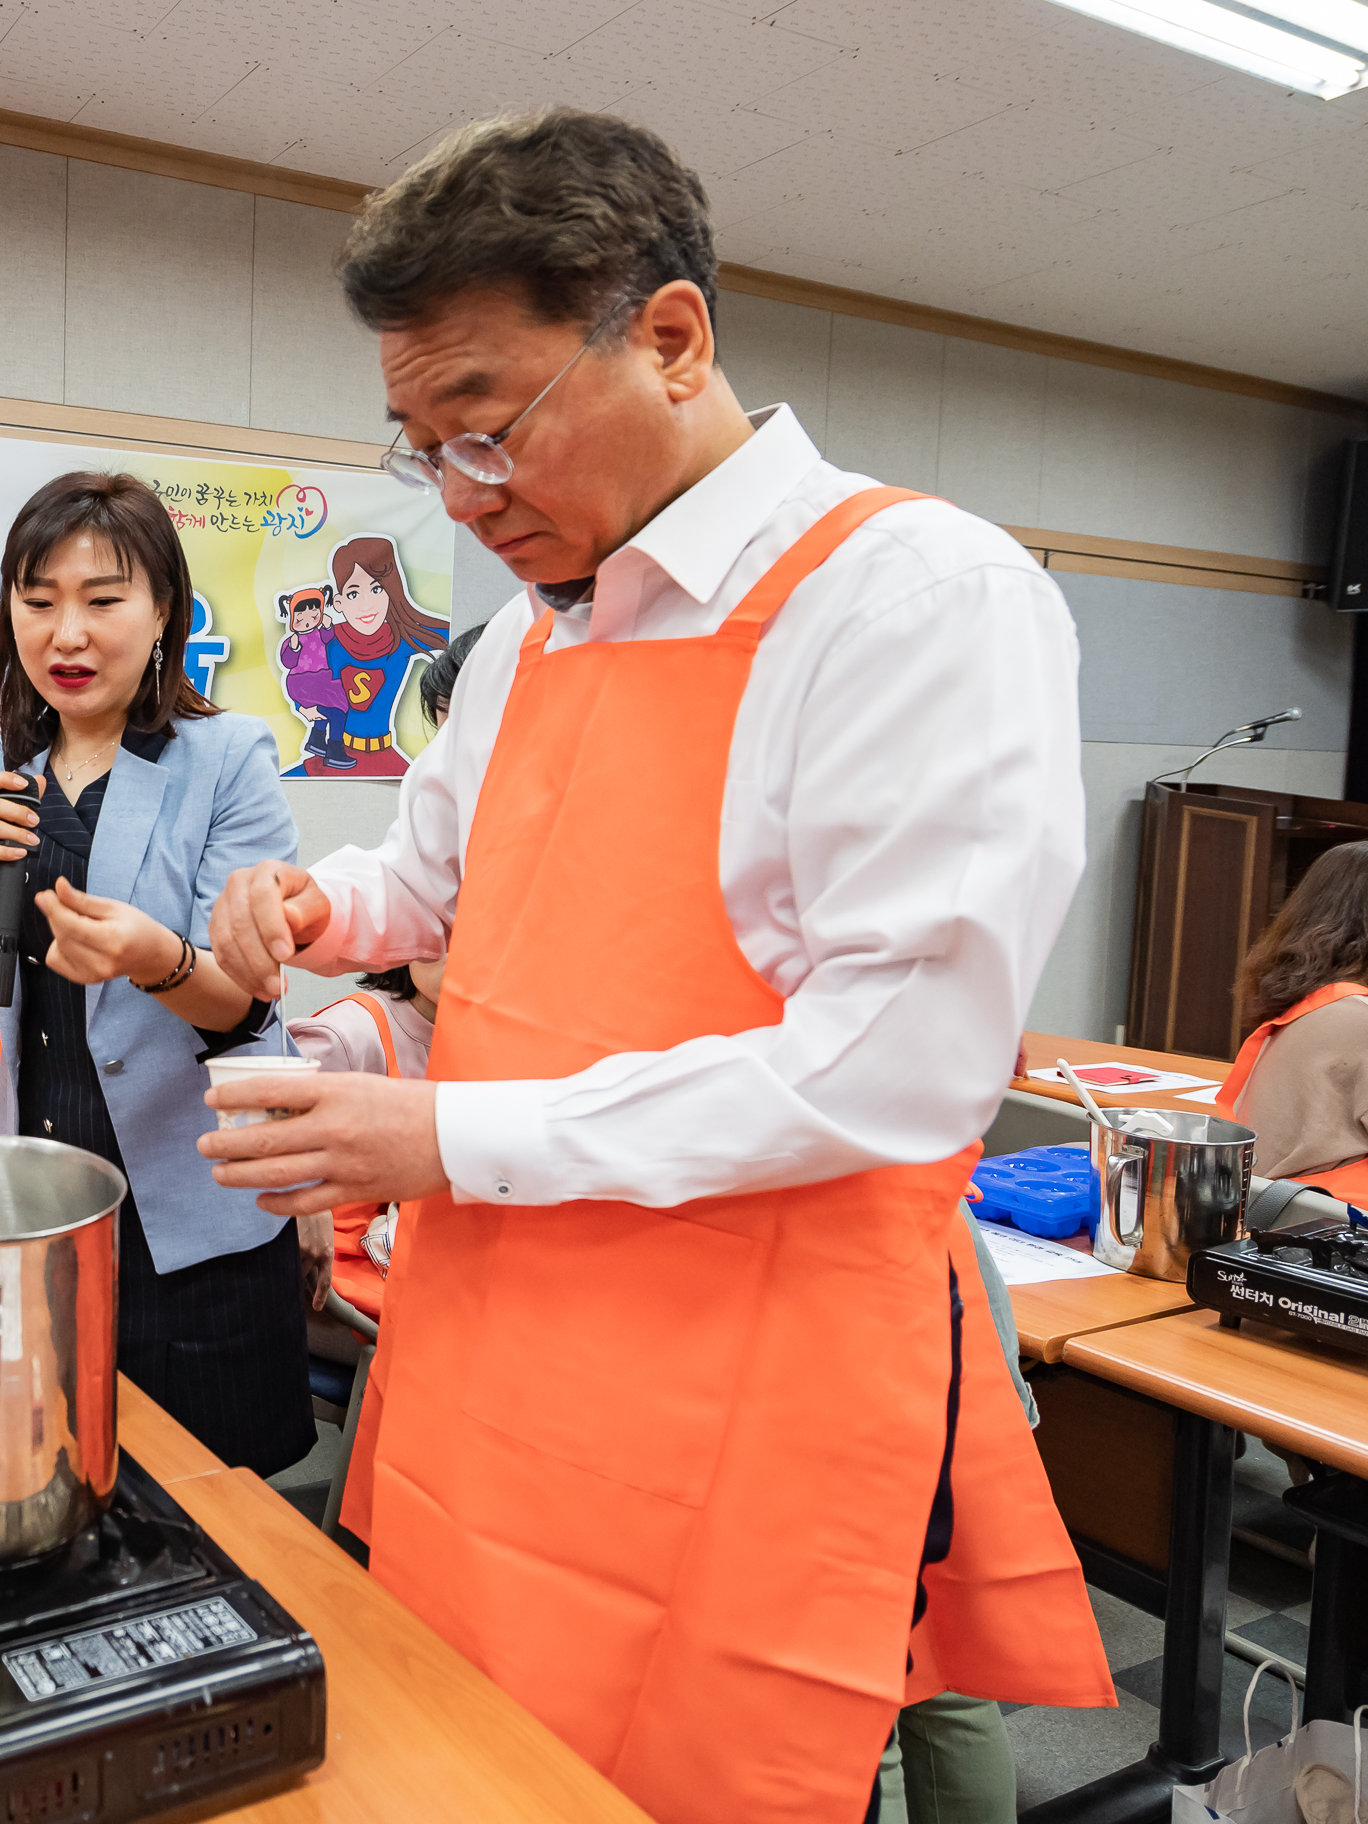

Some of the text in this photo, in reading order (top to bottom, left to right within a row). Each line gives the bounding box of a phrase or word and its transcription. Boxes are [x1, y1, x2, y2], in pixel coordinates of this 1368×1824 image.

[195, 482, 242, 511] 꿈꾸는
[244, 490, 274, 507] 가치
[167, 505, 308, 538] 함께 만드는 광진
[348, 671, 372, 704] S
[1230, 1285, 1274, 1307] 썬터치
[1278, 1297, 1345, 1324] Original
